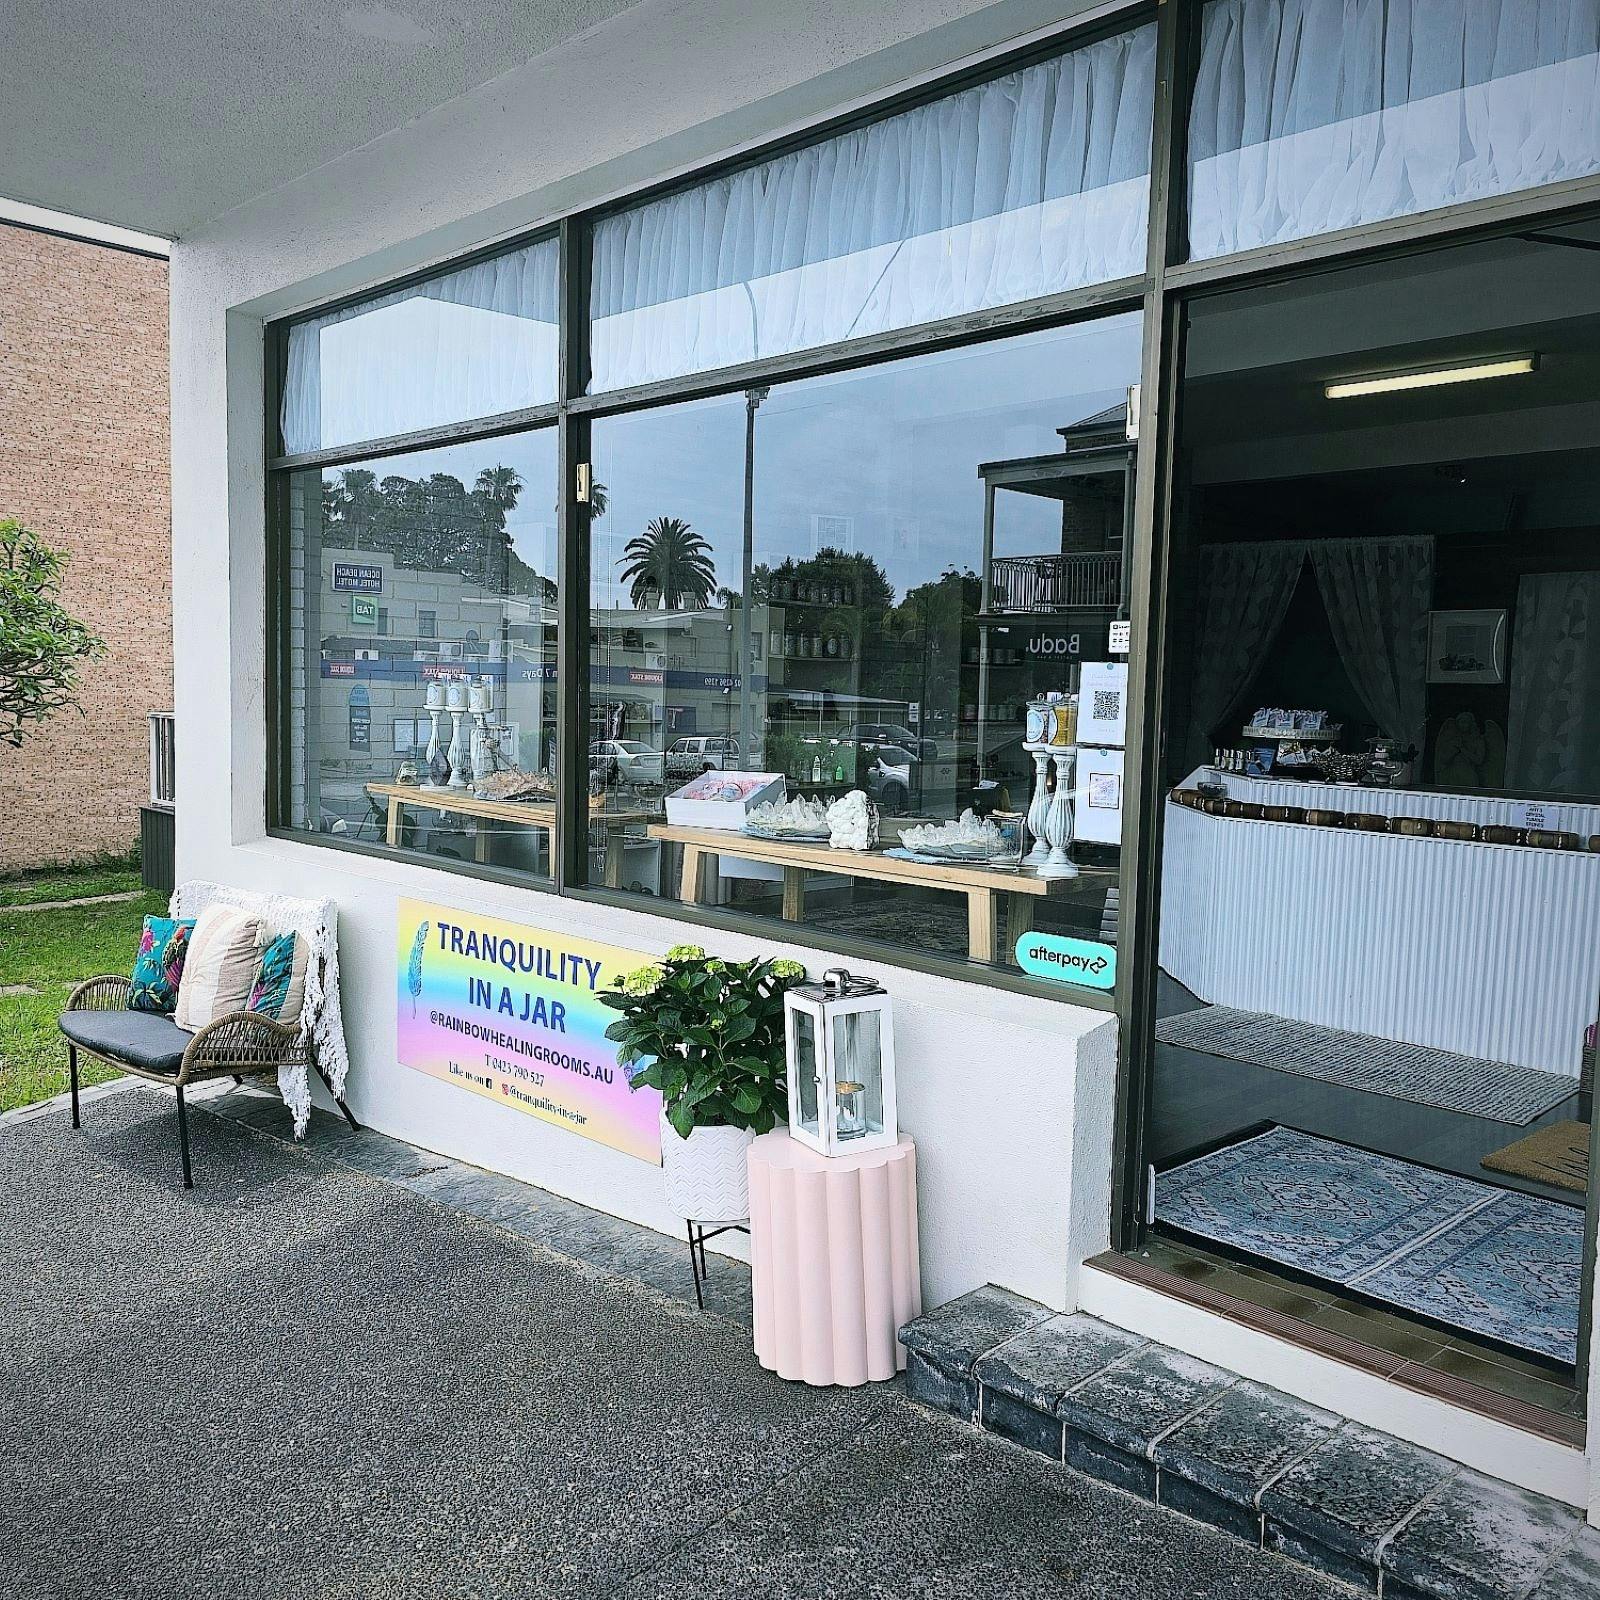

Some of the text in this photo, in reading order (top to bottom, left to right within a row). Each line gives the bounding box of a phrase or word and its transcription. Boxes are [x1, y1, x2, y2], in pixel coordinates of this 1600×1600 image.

[437, 921, 602, 991] TRANQUILITY
[1030, 947, 1090, 971] afterpay
[469, 976, 566, 1033] IN A JAR
[430, 1010, 614, 1085] @RAINBOWHEALINGROOMS.AU
[485, 1053, 545, 1088] T 0423 790 527
[448, 1060, 484, 1086] Like us on
